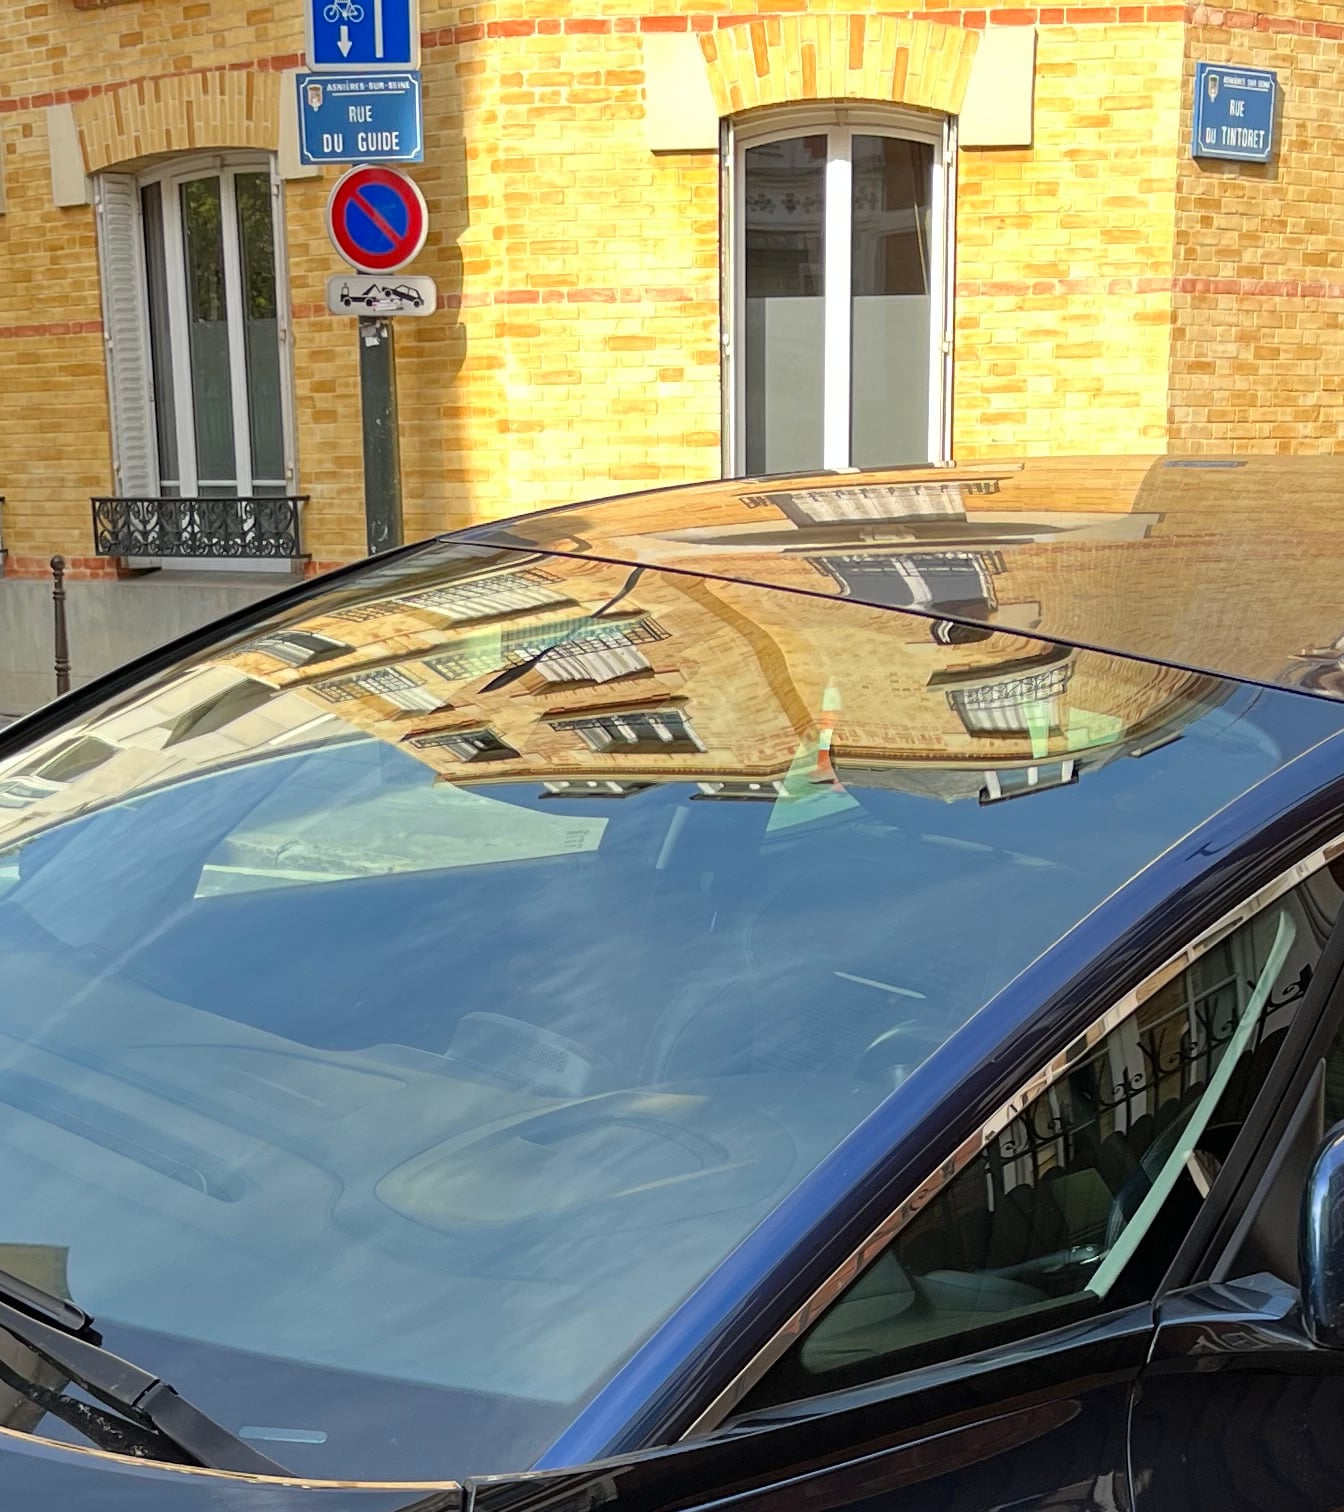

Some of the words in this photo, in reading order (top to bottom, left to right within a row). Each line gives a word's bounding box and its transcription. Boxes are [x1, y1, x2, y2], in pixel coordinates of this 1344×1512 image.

[348, 105, 373, 123] RUE
[1229, 99, 1245, 117] RUE
[323, 133, 343, 153] DU
[357, 131, 400, 152] GUIDE
[1205, 127, 1216, 144] DU
[1221, 126, 1265, 148] TINTORET
